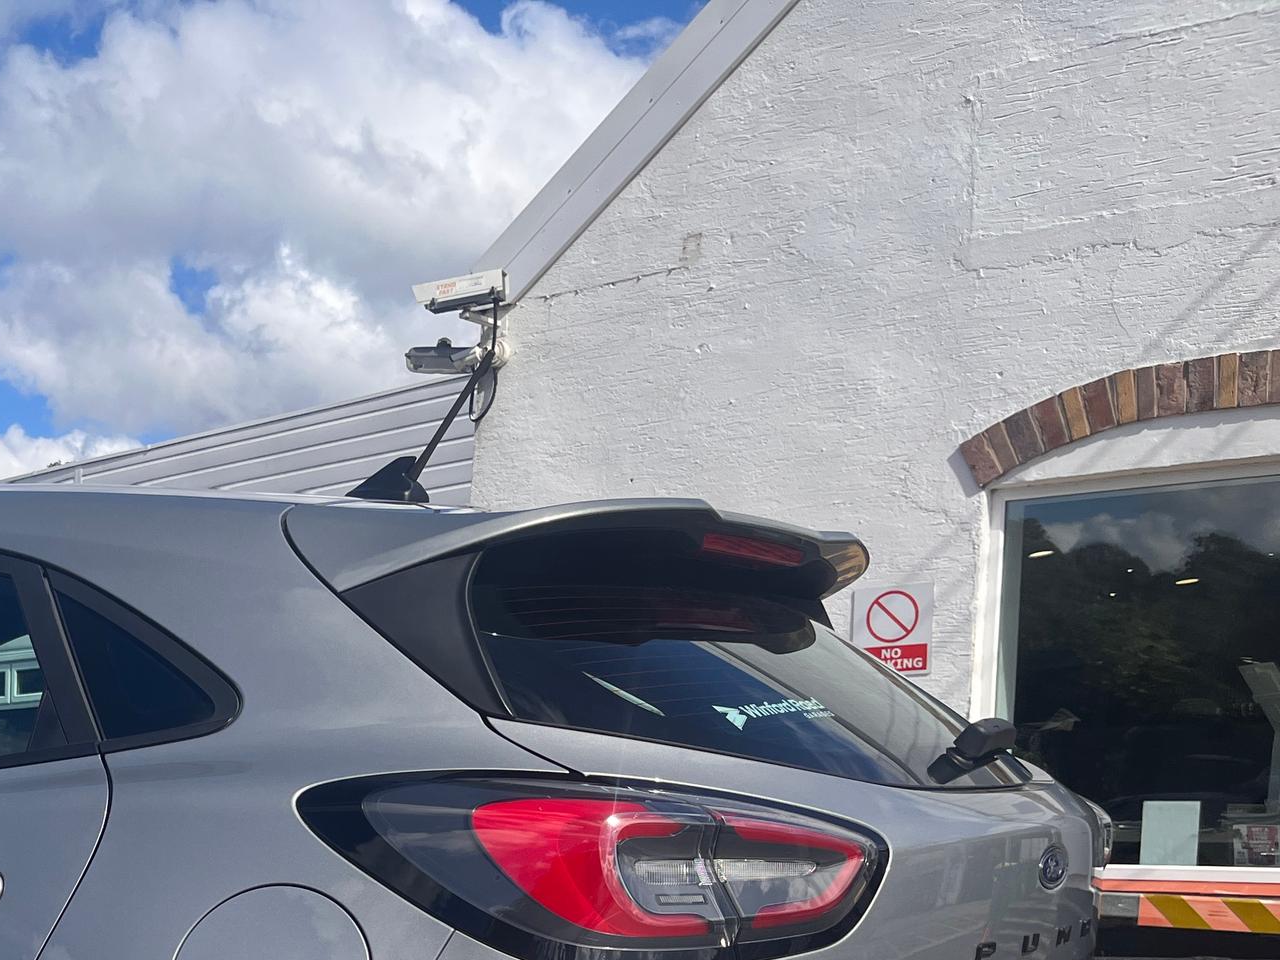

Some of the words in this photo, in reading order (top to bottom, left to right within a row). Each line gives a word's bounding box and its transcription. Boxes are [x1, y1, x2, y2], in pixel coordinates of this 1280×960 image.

[880, 647, 902, 659] NO
[881, 657, 923, 670] KING
[738, 699, 797, 718] Winford
[787, 697, 826, 712] Road
